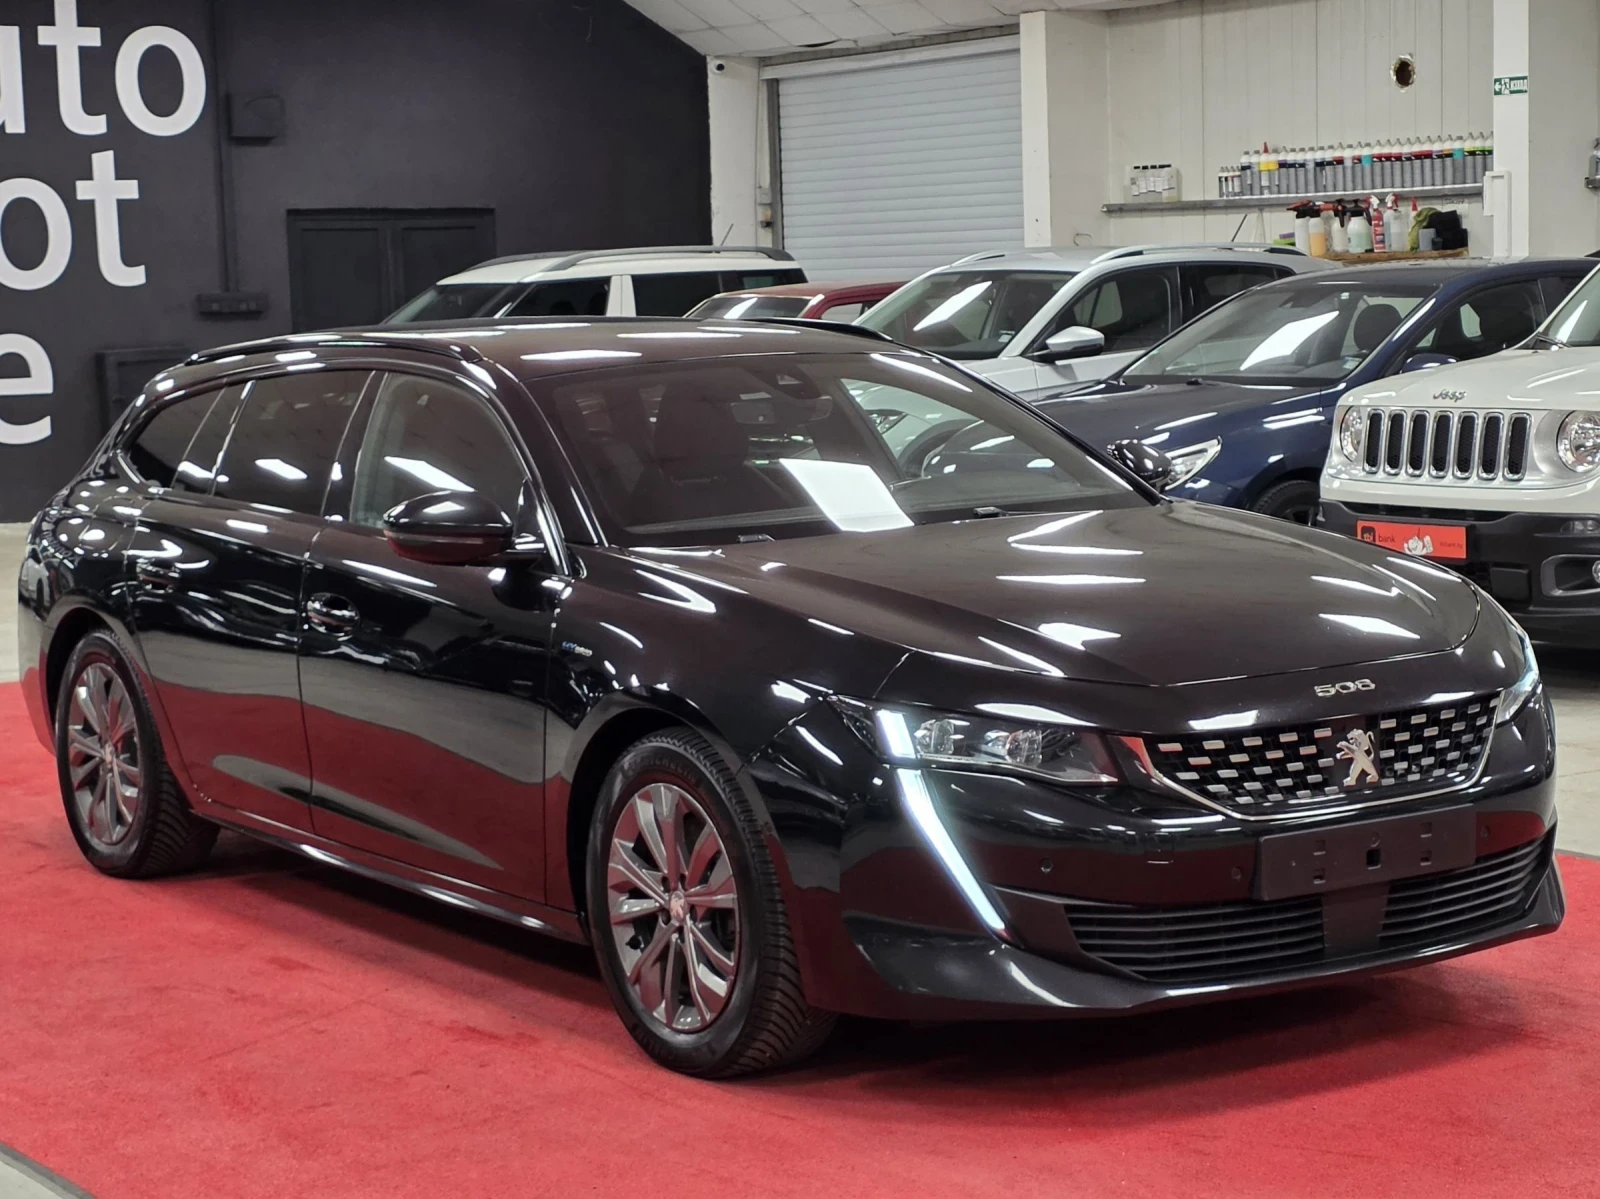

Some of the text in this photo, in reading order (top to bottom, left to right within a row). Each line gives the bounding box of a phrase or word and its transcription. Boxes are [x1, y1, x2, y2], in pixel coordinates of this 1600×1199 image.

[1432, 388, 1467, 403] Jeep
[1378, 534, 1396, 543] bank
[1314, 678, 1376, 697] 508
